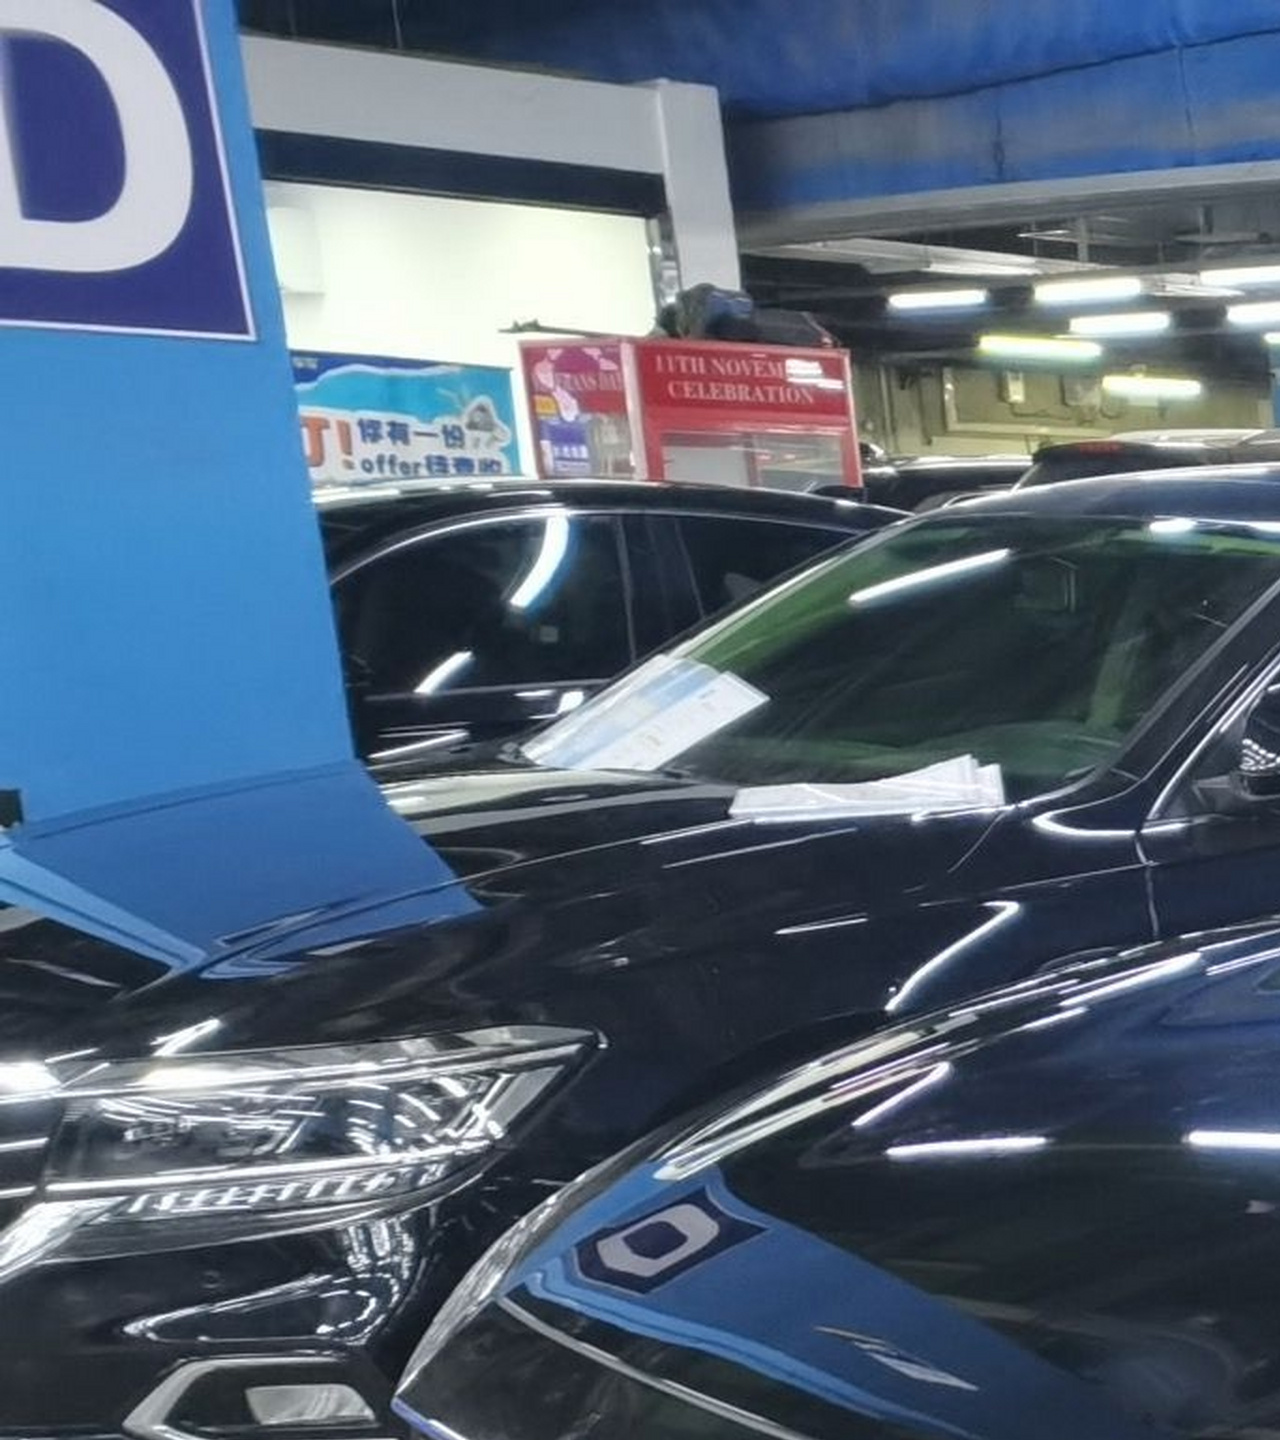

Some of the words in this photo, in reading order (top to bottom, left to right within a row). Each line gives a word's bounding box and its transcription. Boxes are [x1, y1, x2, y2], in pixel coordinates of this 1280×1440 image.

[0, 0, 193, 273] D
[711, 357, 808, 380] NOVEM
[667, 380, 815, 404] CELEBRATION
[358, 418, 467, 449] 你有一份
